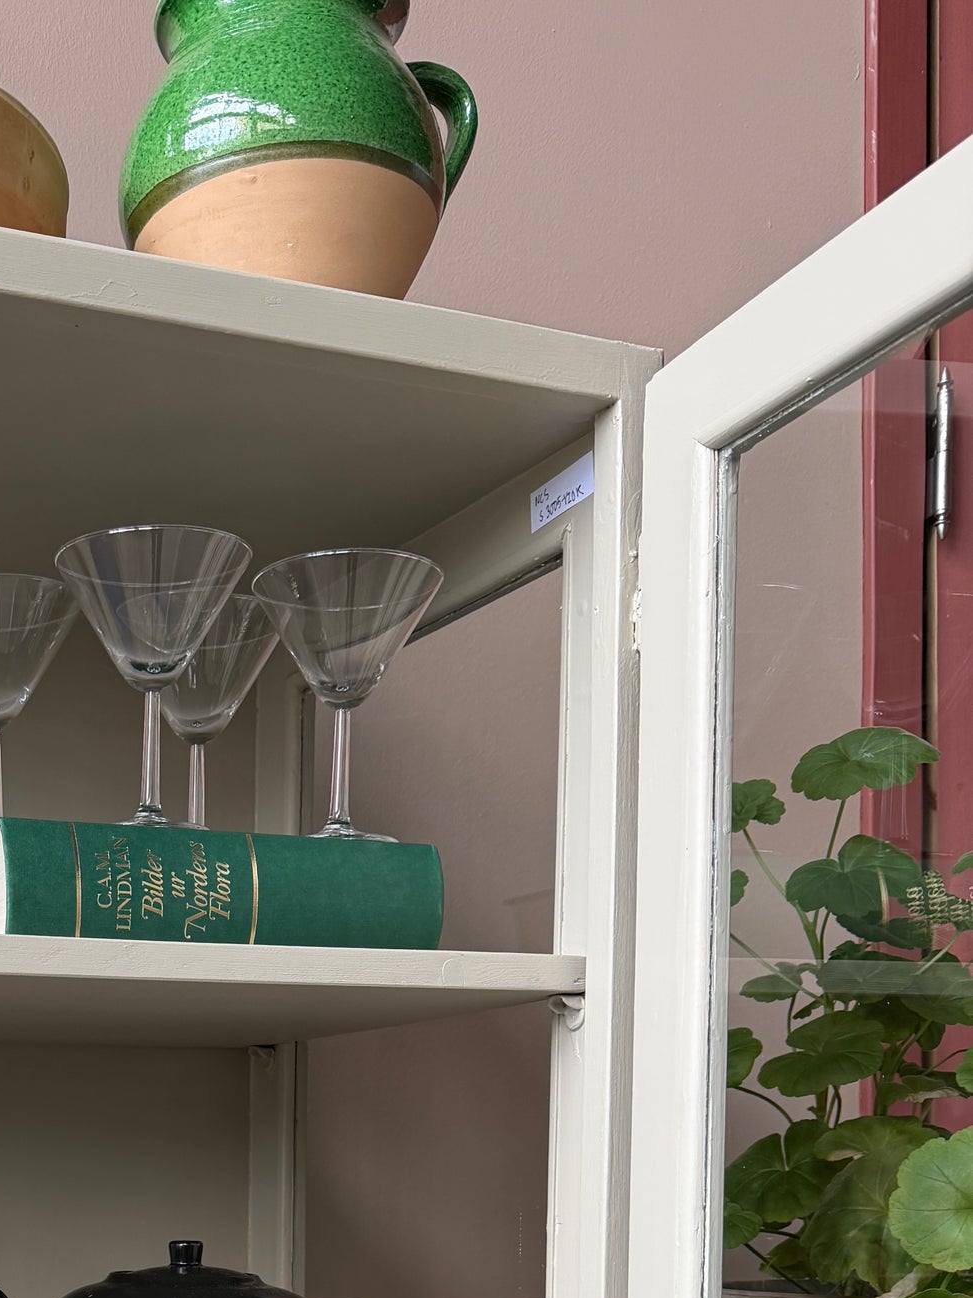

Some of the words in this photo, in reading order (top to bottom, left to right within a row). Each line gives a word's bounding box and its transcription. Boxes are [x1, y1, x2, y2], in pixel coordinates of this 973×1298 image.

[112, 835, 132, 931] LINDMAN
[140, 849, 164, 920] Bilder
[170, 871, 186, 899] ur
[183, 840, 209, 940] Nordens
[209, 861, 231, 921] Flora
